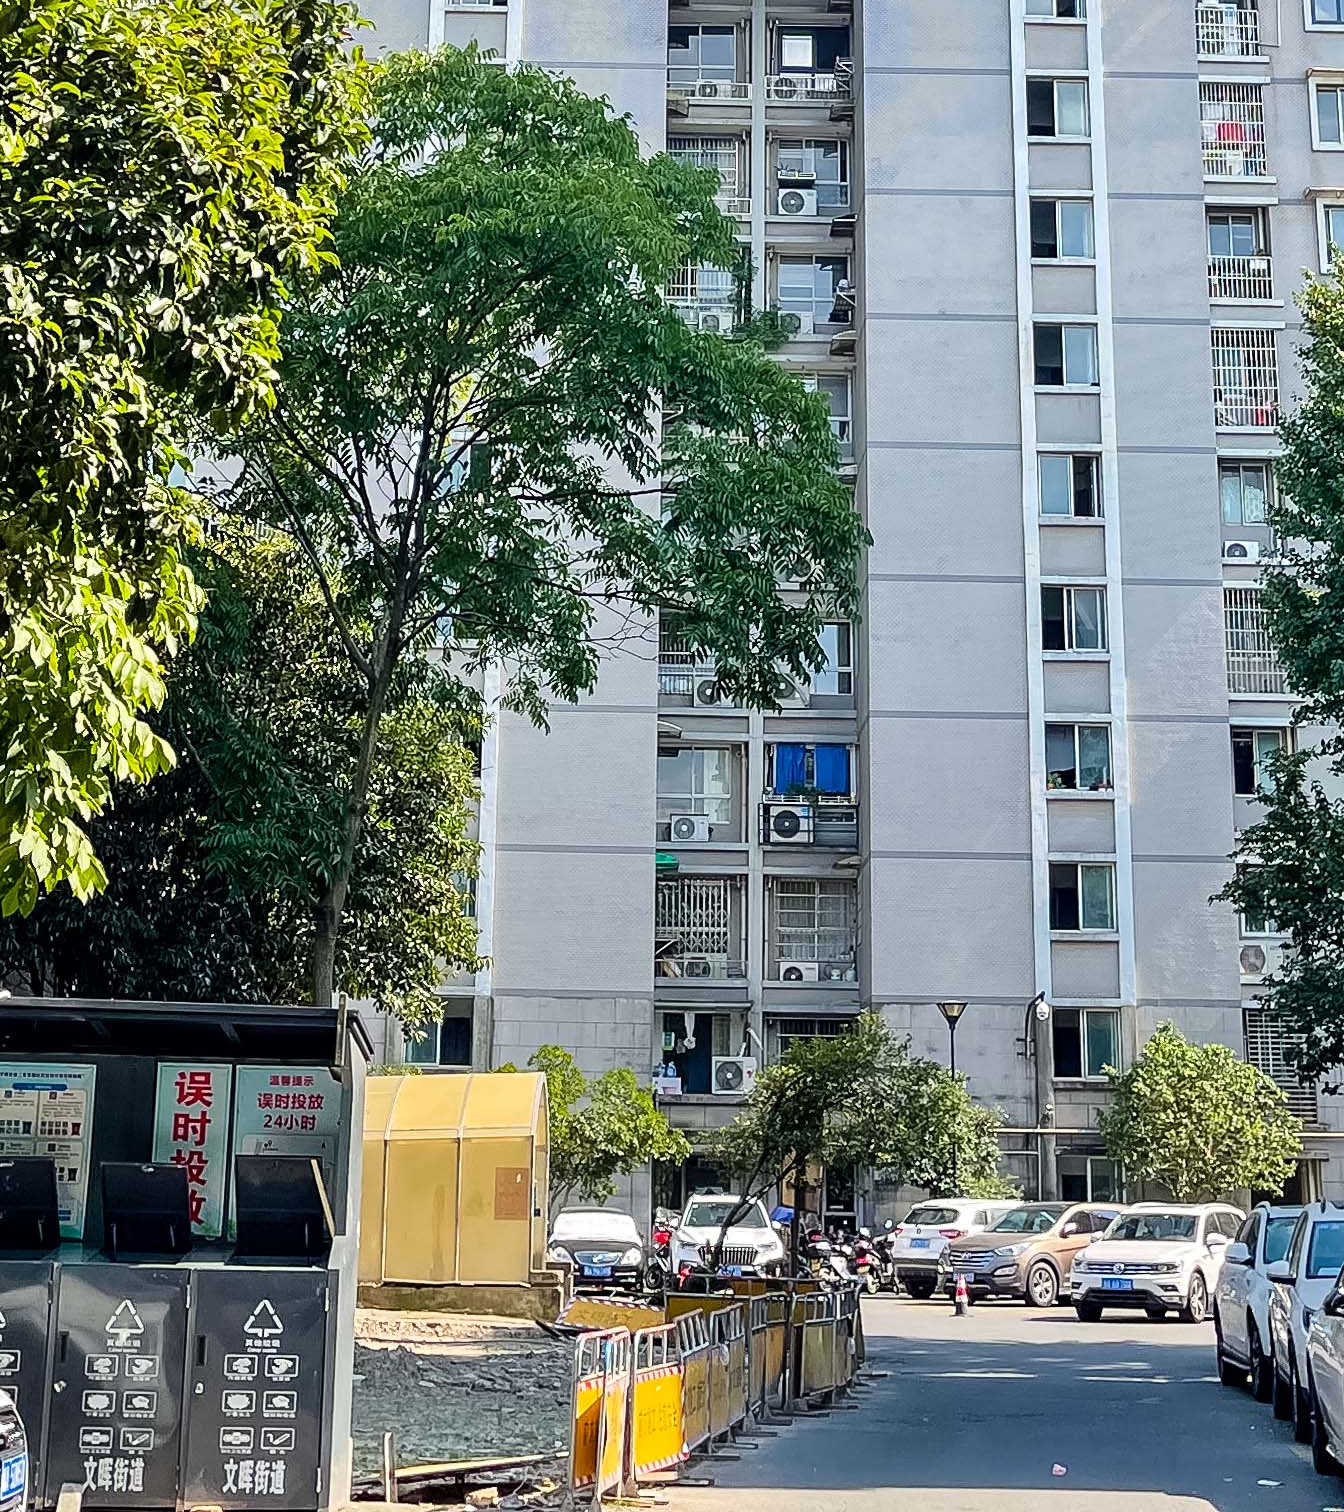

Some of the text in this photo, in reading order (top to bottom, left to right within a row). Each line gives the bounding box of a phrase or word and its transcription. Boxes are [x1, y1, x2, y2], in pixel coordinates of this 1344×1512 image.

[257, 1093, 324, 1110] 误时投放
[263, 1114, 316, 1131] 24小时
[82, 1456, 145, 1492] 文晖街道
[222, 1458, 286, 1495] 文晖街道
